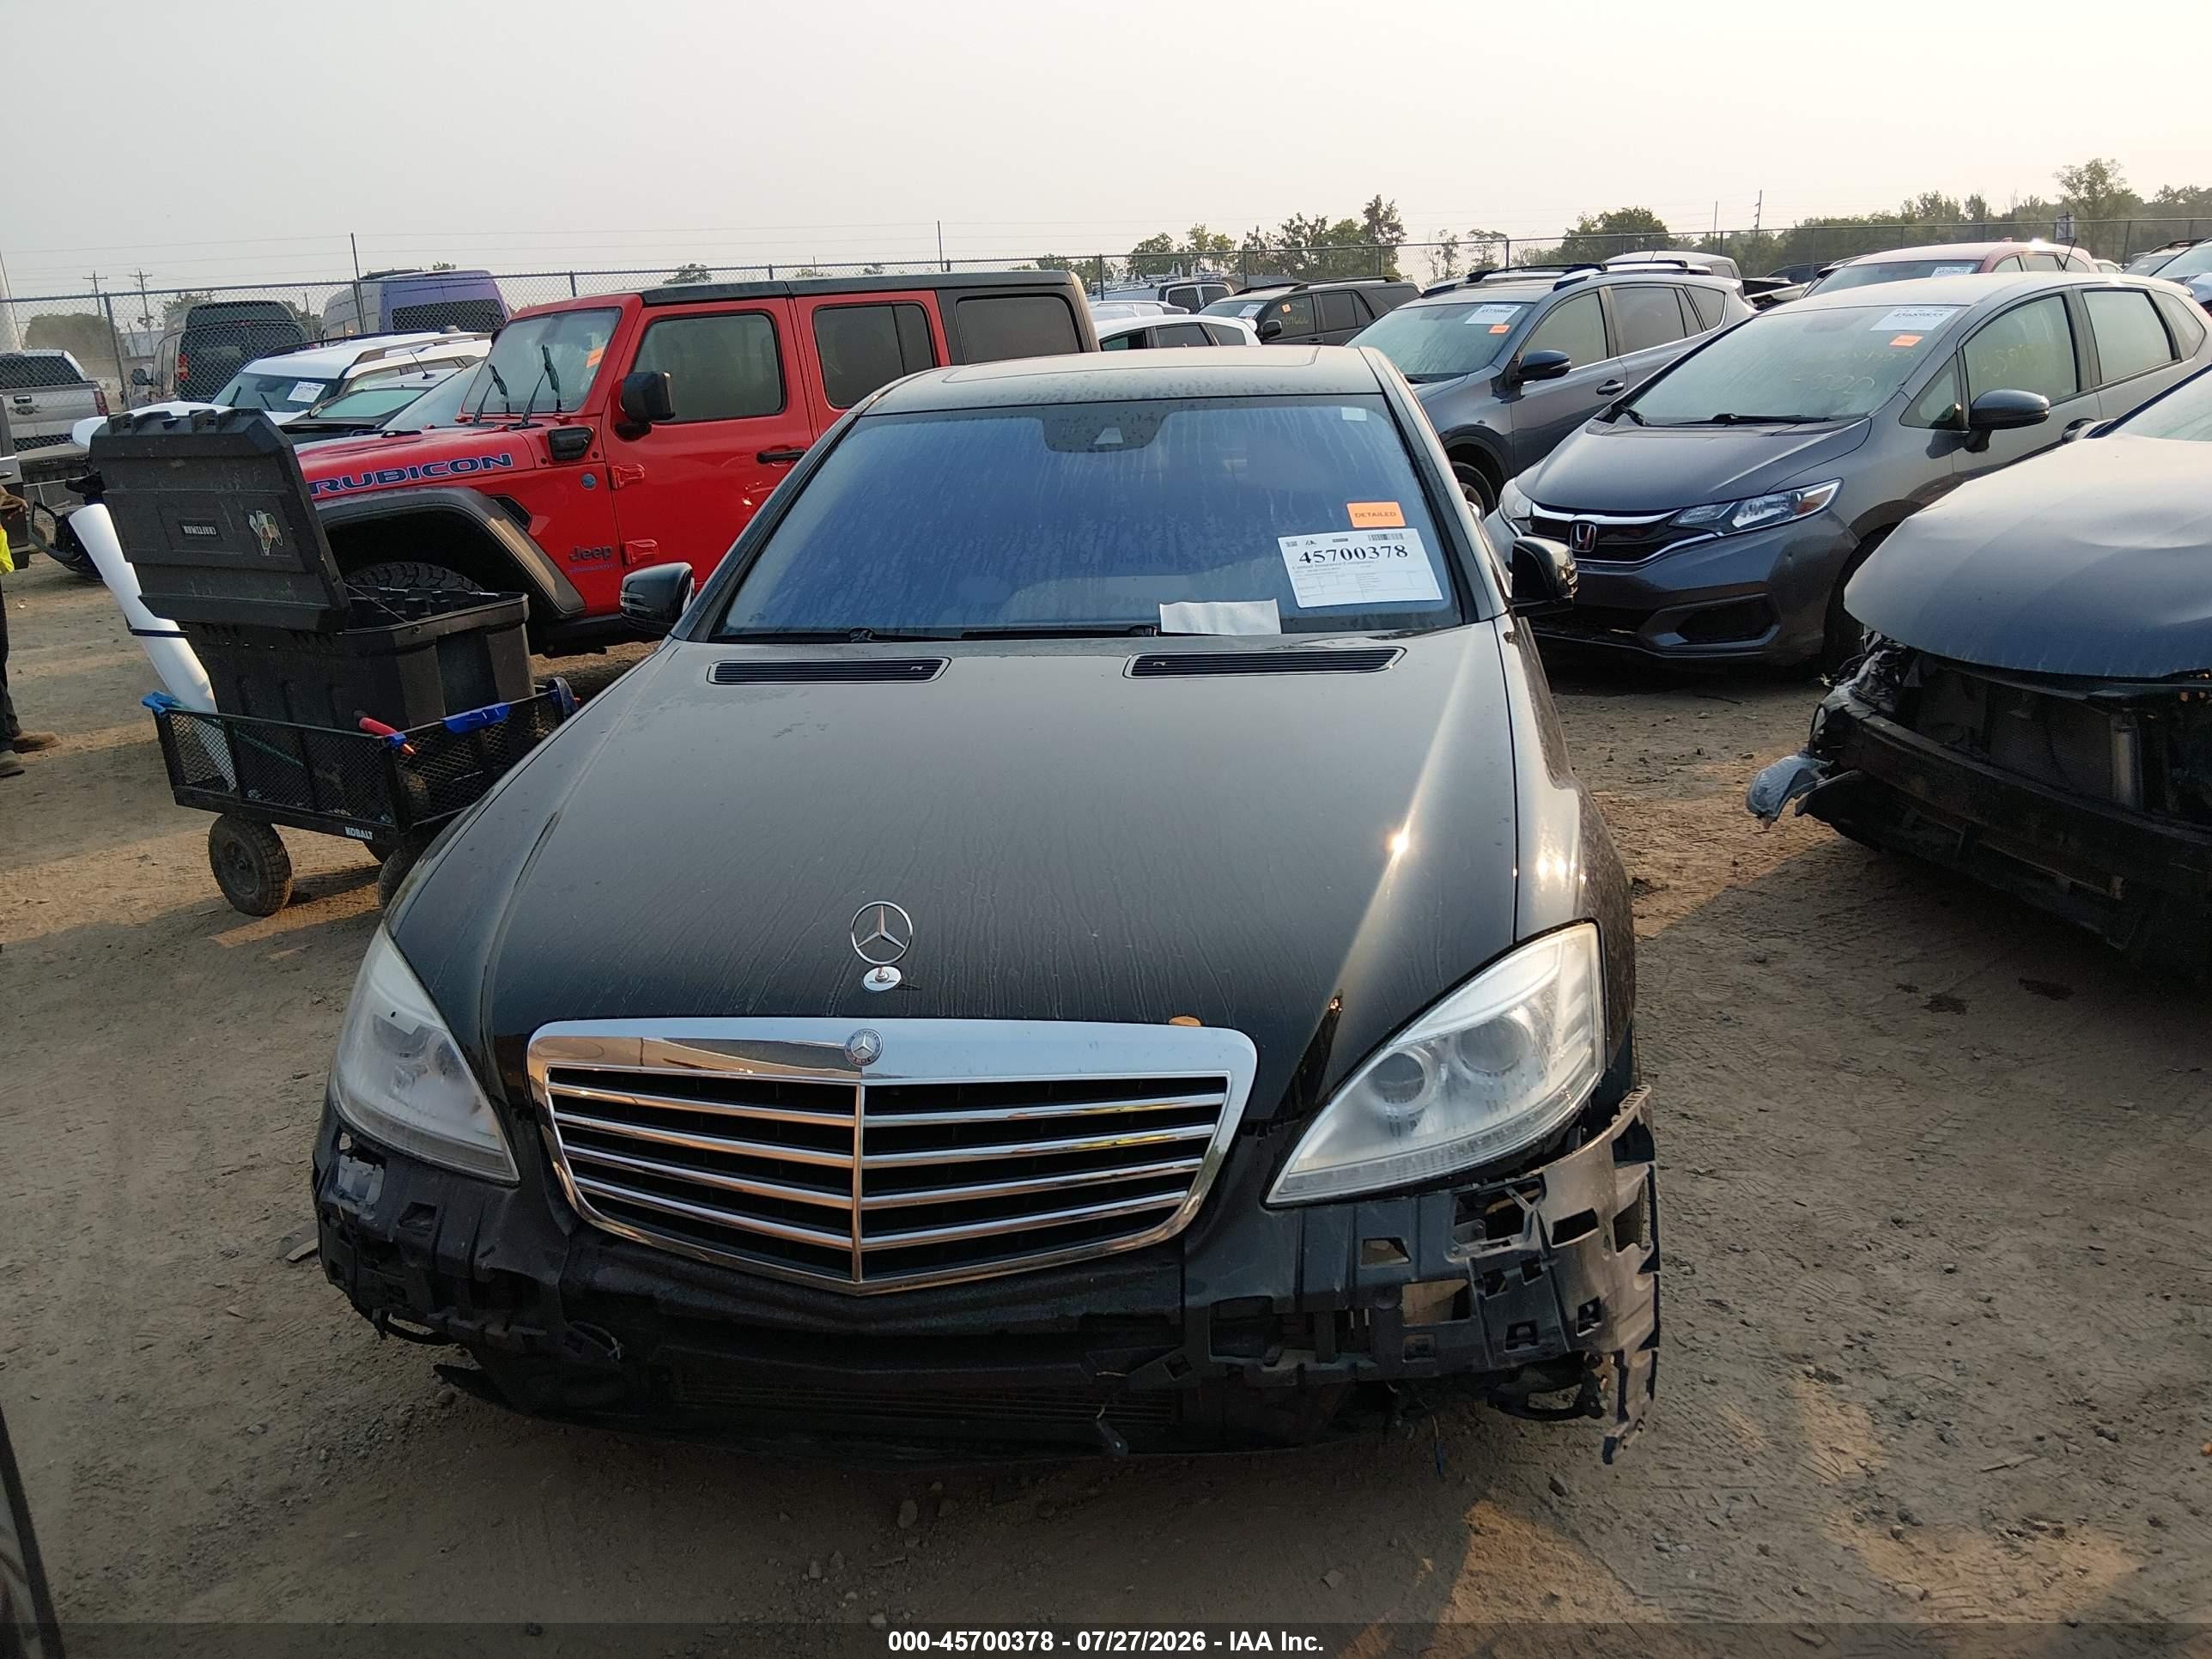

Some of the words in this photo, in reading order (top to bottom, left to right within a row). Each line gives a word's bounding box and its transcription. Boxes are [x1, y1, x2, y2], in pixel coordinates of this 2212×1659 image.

[308, 453, 514, 495] RUBICON
[568, 545, 613, 562] Jeep
[1298, 544, 1408, 564] 45700378
[344, 826, 374, 841] KOBALT
